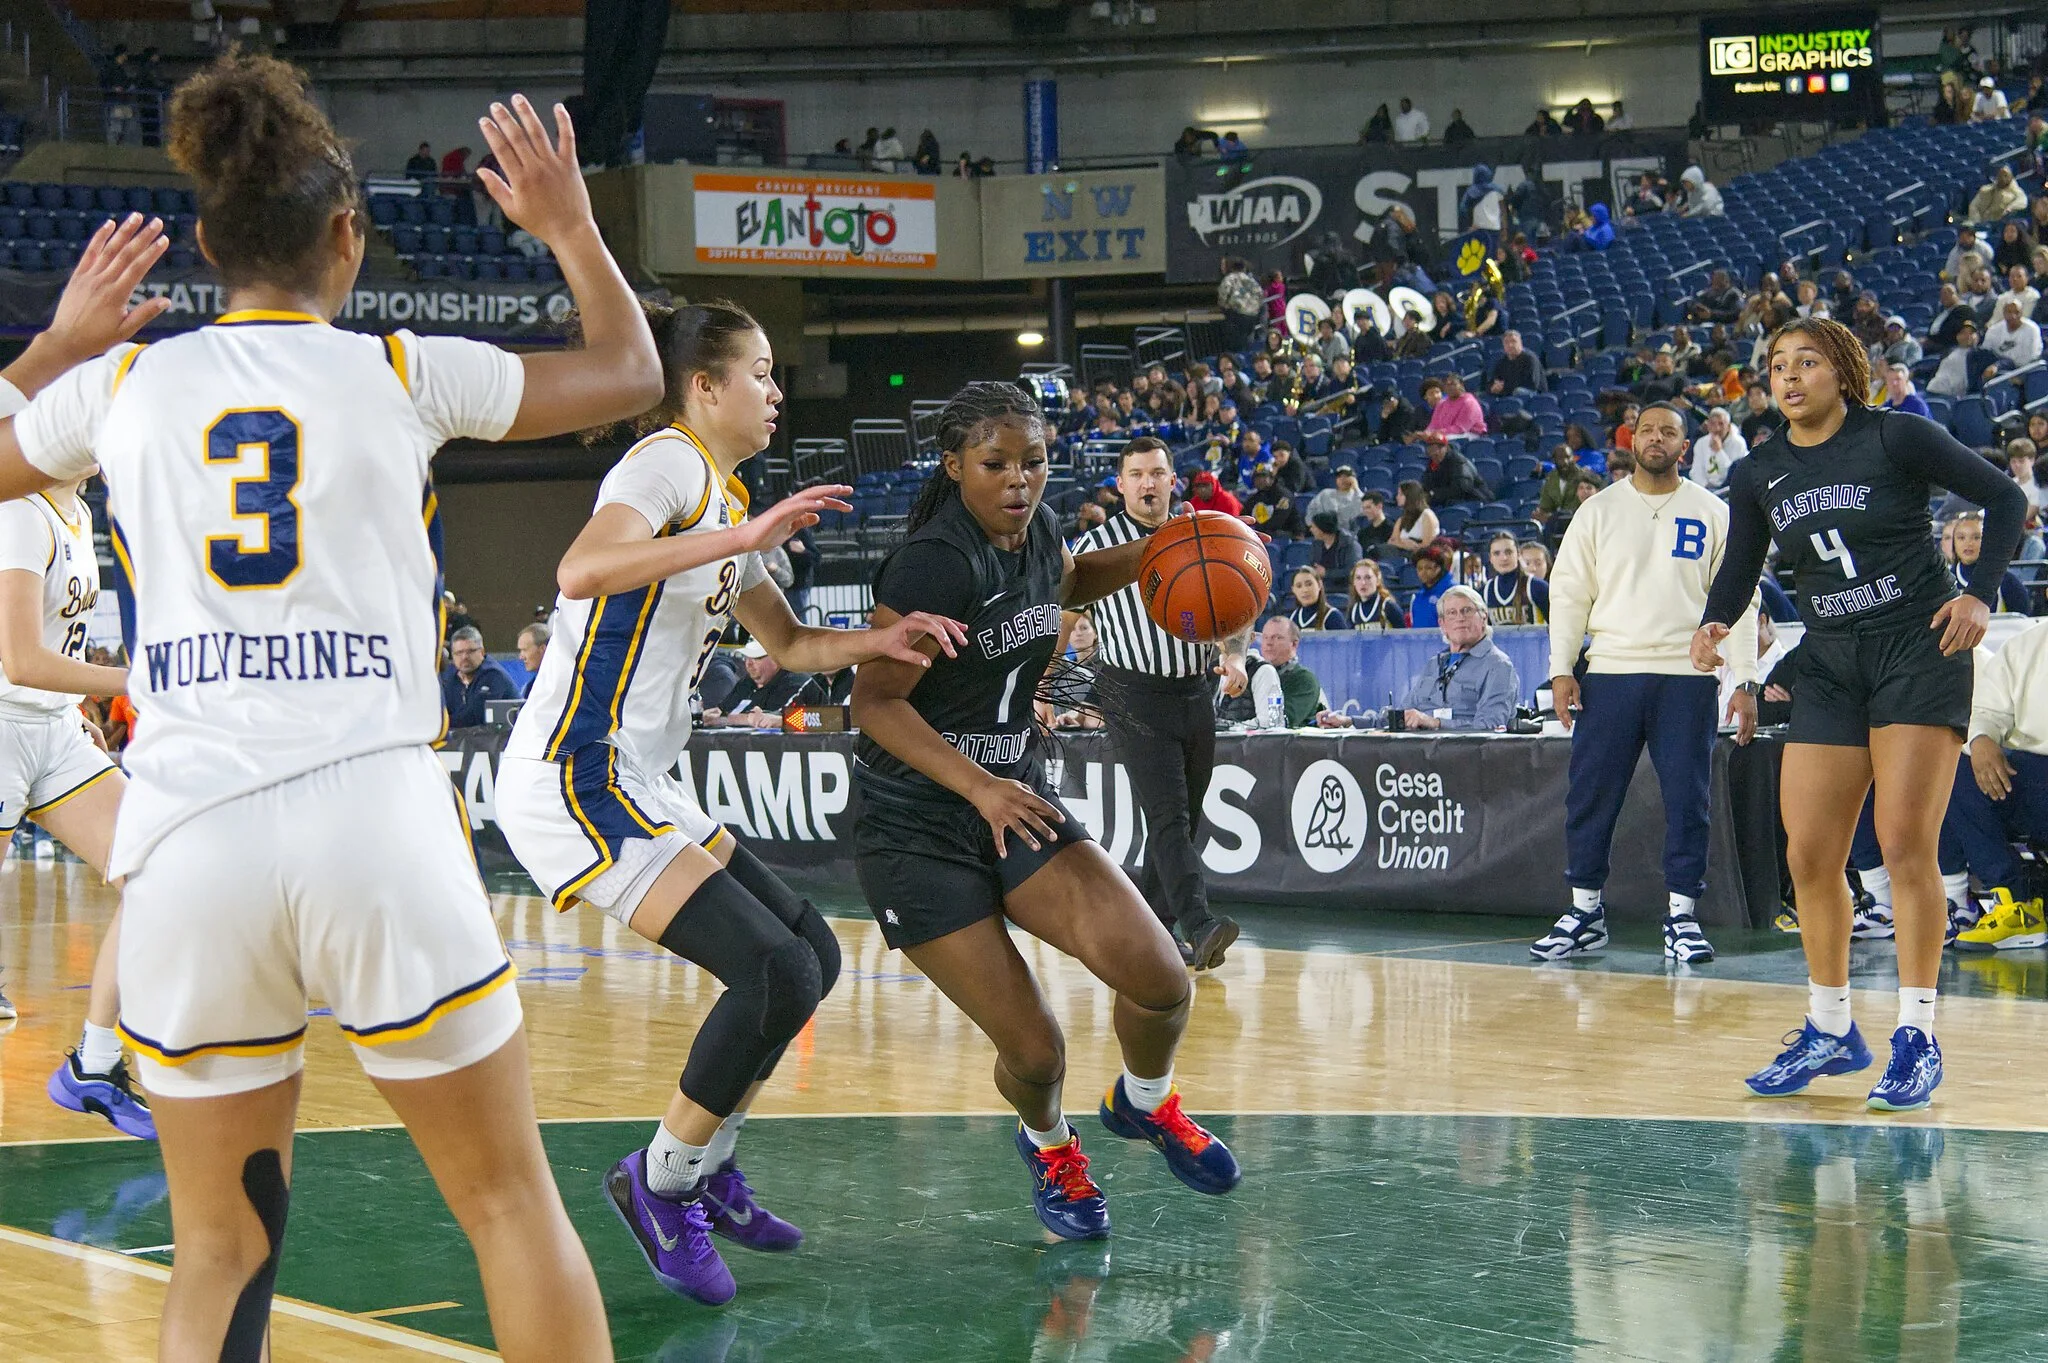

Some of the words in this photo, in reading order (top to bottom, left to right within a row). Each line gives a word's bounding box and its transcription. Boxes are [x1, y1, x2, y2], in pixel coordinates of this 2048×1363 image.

[1715, 42, 1751, 69] IG
[1759, 29, 1871, 54] INDUSTRY
[1759, 47, 1873, 73] GRAPHICS
[1090, 185, 1136, 217] W
[1211, 196, 1301, 226] WIAA
[878, 254, 926, 265] TACOMA
[1024, 228, 1146, 263] EXIT
[204, 406, 304, 592] 3
[1770, 484, 1871, 532] EASTSIDE
[1671, 517, 1707, 561] B
[1809, 528, 1858, 580] 4
[1811, 574, 1902, 618] CATHOLIC
[977, 603, 1063, 660] EASTSID
[145, 630, 392, 693] WOLVERINES
[996, 656, 1032, 723] 1
[803, 711, 823, 728] POSS.
[1375, 762, 1444, 799] Gesa
[1376, 800, 1466, 835] Credit
[1377, 835, 1450, 870] Union
